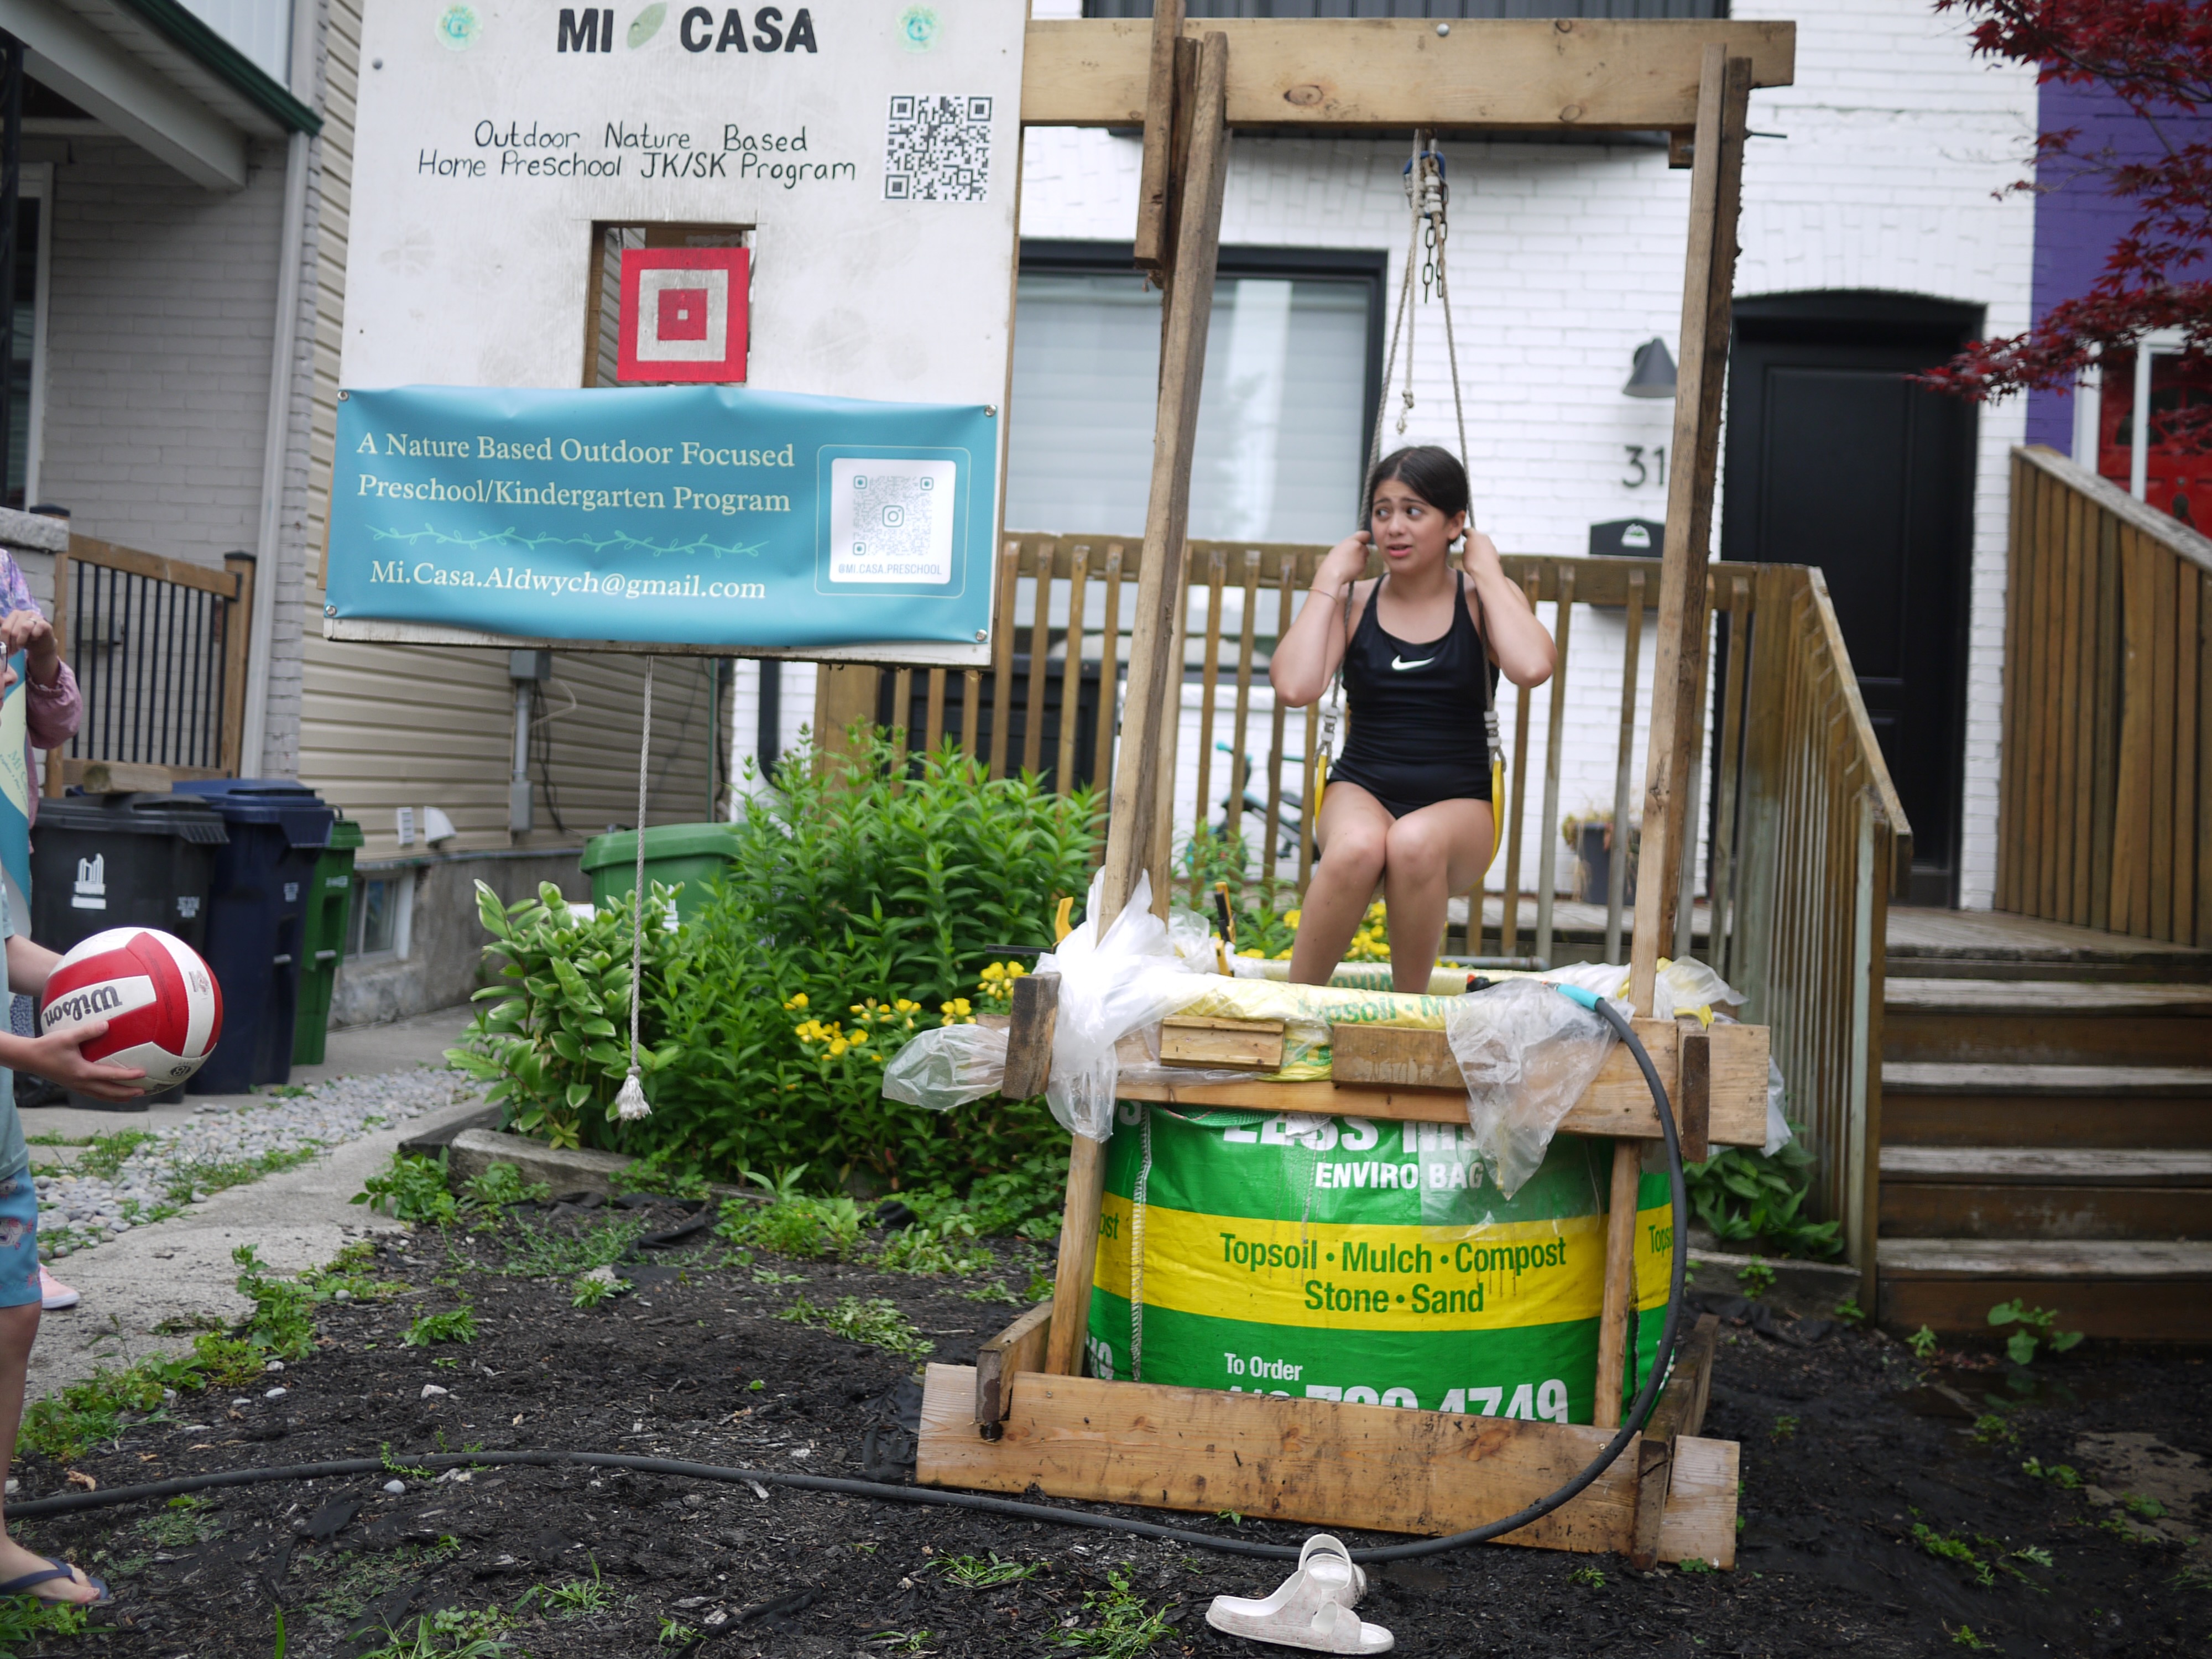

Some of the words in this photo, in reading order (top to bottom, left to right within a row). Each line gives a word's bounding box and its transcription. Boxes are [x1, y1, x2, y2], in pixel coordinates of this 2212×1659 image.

[558, 8, 614, 53] MI
[681, 7, 817, 53] CASA
[475, 119, 580, 148] Outdoor
[605, 121, 690, 149] Nature
[724, 123, 807, 152] Based
[419, 149, 486, 176] Home
[501, 150, 621, 178] Preschool
[641, 152, 727, 178] JK/SK
[742, 154, 855, 189] Program
[357, 432, 378, 455] A
[385, 433, 470, 458] Nature
[478, 436, 553, 461] Based
[560, 438, 674, 465] Outdoor
[681, 442, 795, 467] Focused
[1622, 445, 1665, 488] 31
[357, 474, 665, 511] Preschool/Kindergarten
[674, 487, 791, 515] Program
[370, 560, 766, 600] Mi.Casa.Aldwych@gmail.com
[838, 564, 942, 575] @MI.CASA.PRESCHOOL
[43, 985, 123, 1027] Wilson
[1315, 1161, 1419, 1189] ENVIRO
[1428, 1162, 1484, 1189] BAG
[1220, 1233, 1317, 1272] Topsoil
[1342, 1241, 1432, 1274] Mulch
[1455, 1237, 1566, 1276] Compost
[1305, 1280, 1389, 1312] Stone
[1412, 1283, 1484, 1314] Sand
[1224, 1353, 1245, 1375] To
[1249, 1356, 1303, 1381] Order
